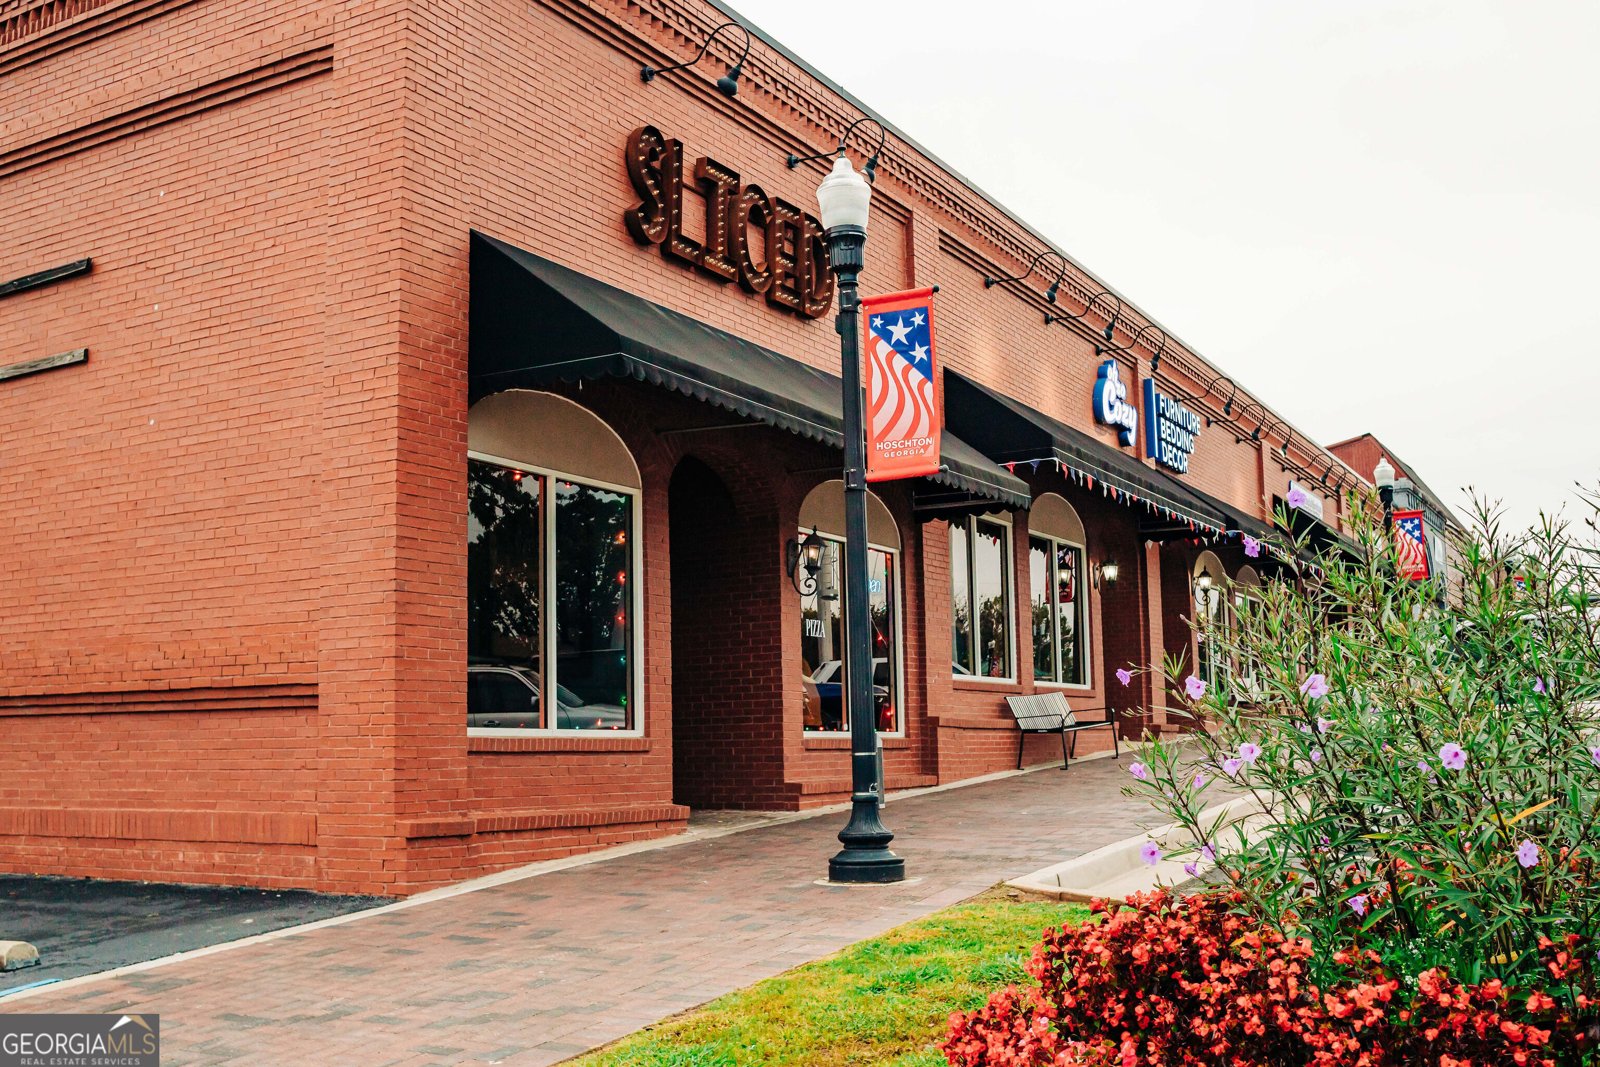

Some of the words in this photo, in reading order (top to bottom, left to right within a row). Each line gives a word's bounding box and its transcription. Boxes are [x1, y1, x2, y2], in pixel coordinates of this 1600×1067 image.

[625, 125, 834, 319] SLICED
[1102, 378, 1138, 446] Cozy
[1159, 393, 1201, 436] FURNITURE
[876, 437, 934, 451] HOSCHTON
[883, 448, 925, 458] GEORGIA
[1160, 417, 1195, 455] BEDDING
[1161, 441, 1189, 474] DECOR
[805, 618, 826, 638] PIZZA
